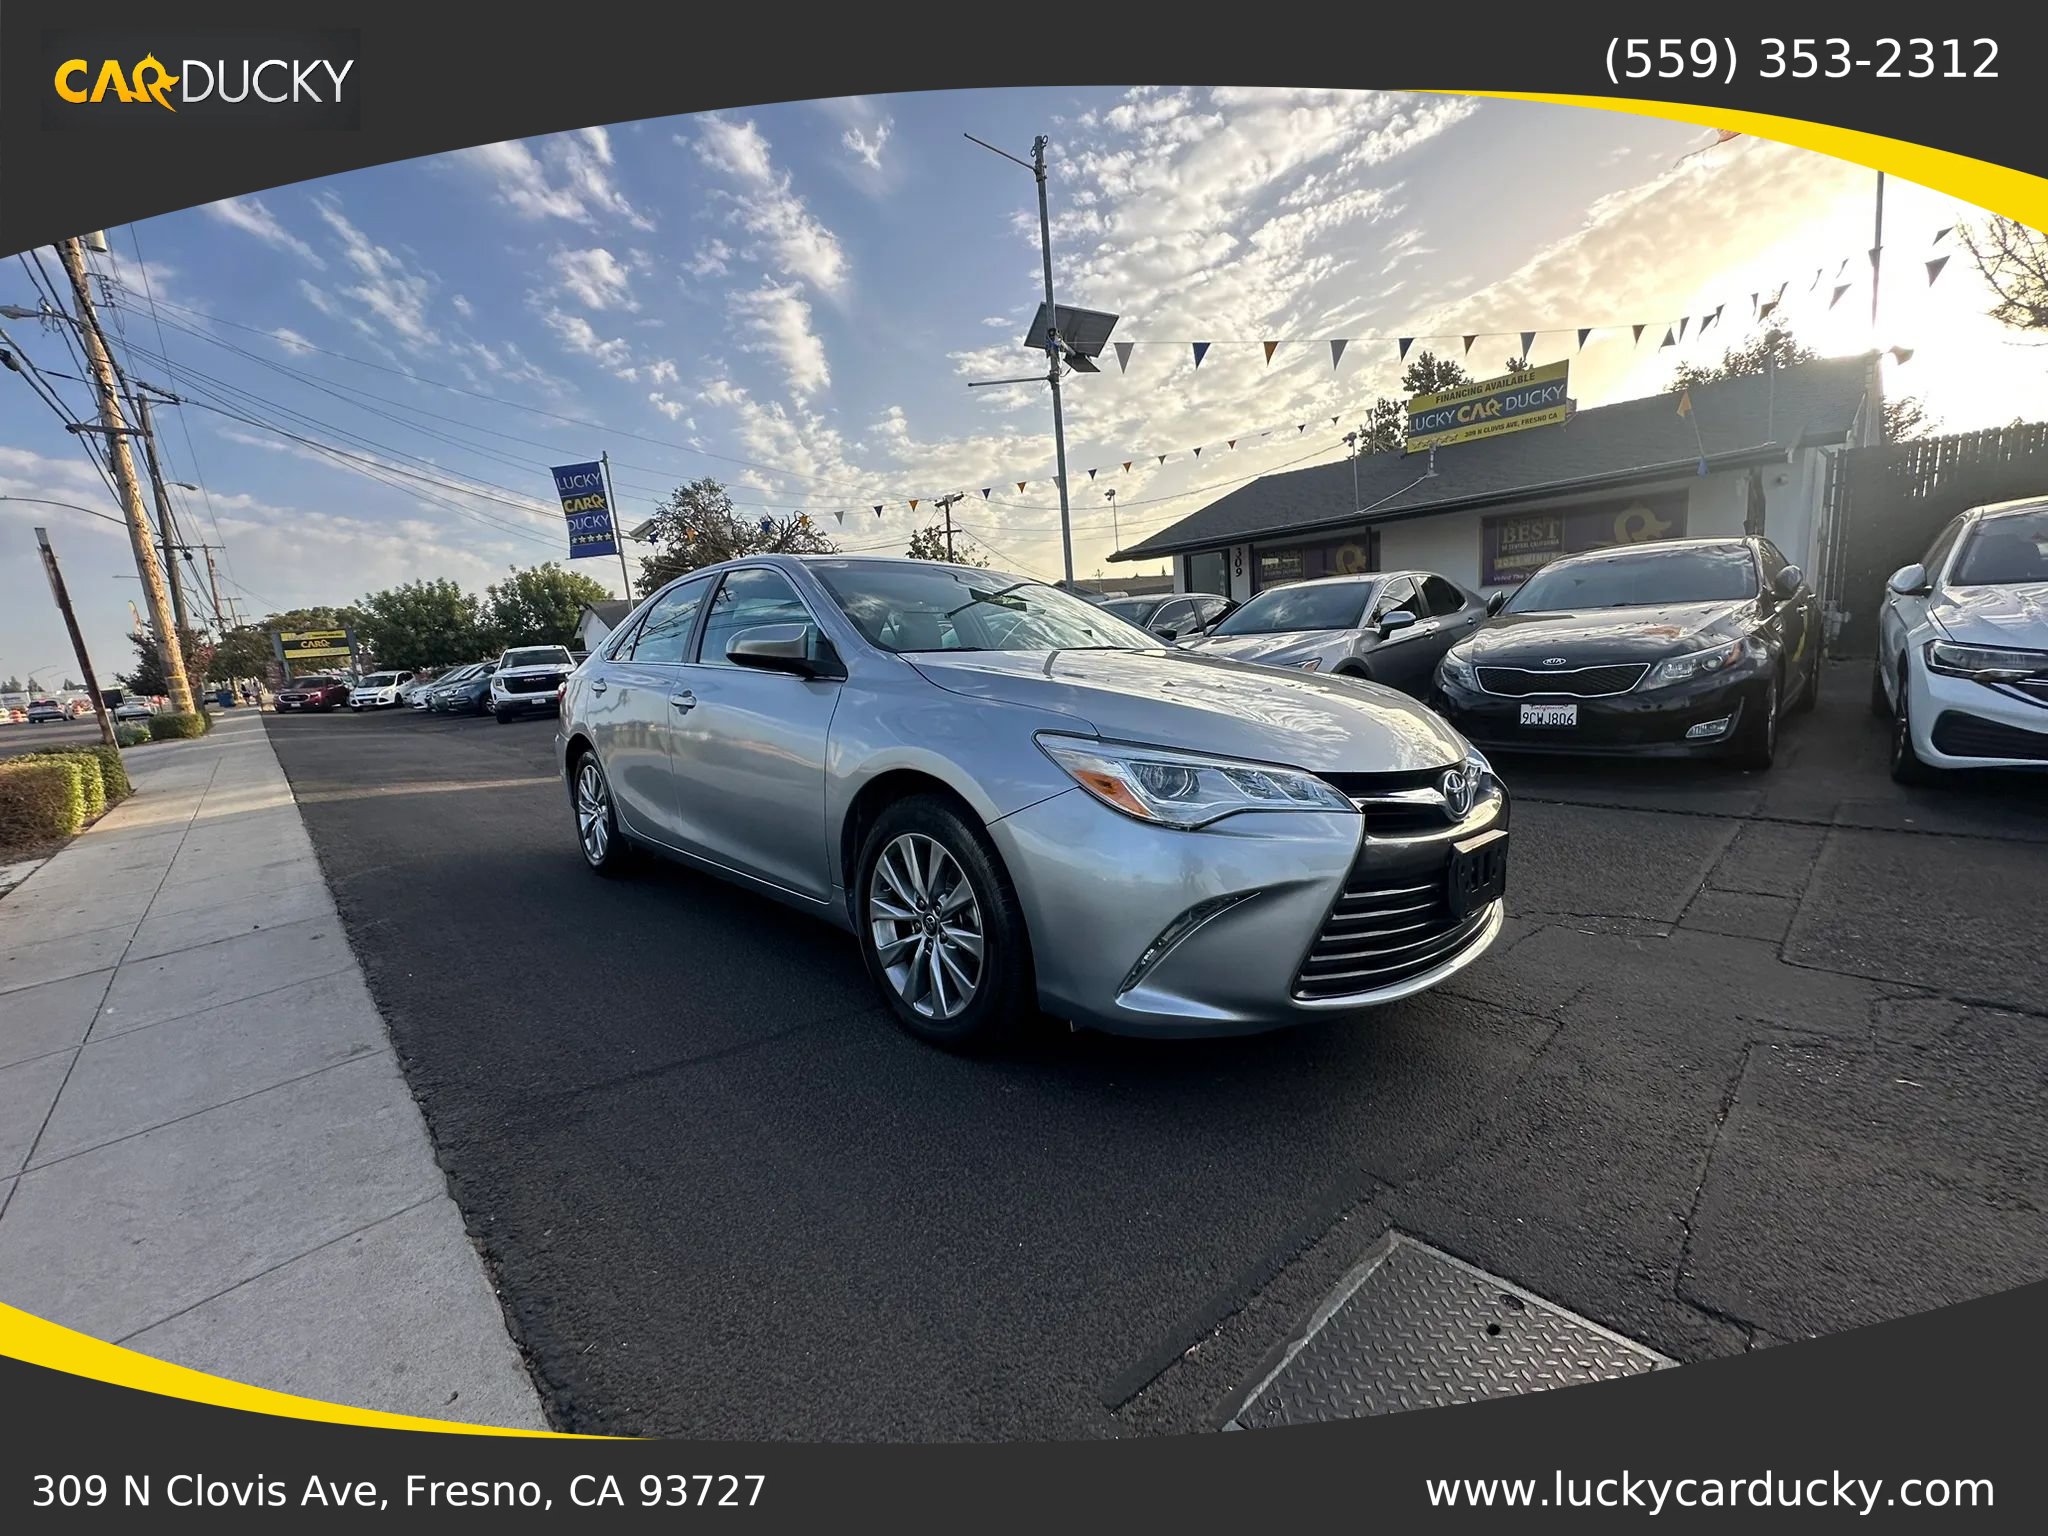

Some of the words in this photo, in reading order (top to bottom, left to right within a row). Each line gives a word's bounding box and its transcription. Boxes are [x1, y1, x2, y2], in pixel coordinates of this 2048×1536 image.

[1435, 386, 1483, 404] FINANCING
[1485, 372, 1536, 393] AVAILABLE
[1409, 410, 1456, 433] LUCKY
[1505, 384, 1565, 412] DUCKY
[1521, 415, 1547, 425] FRESNO
[1548, 412, 1558, 420] CA
[556, 472, 600, 491] LUCKY
[567, 514, 609, 532] DUCKY
[1503, 520, 1560, 543] BEST
